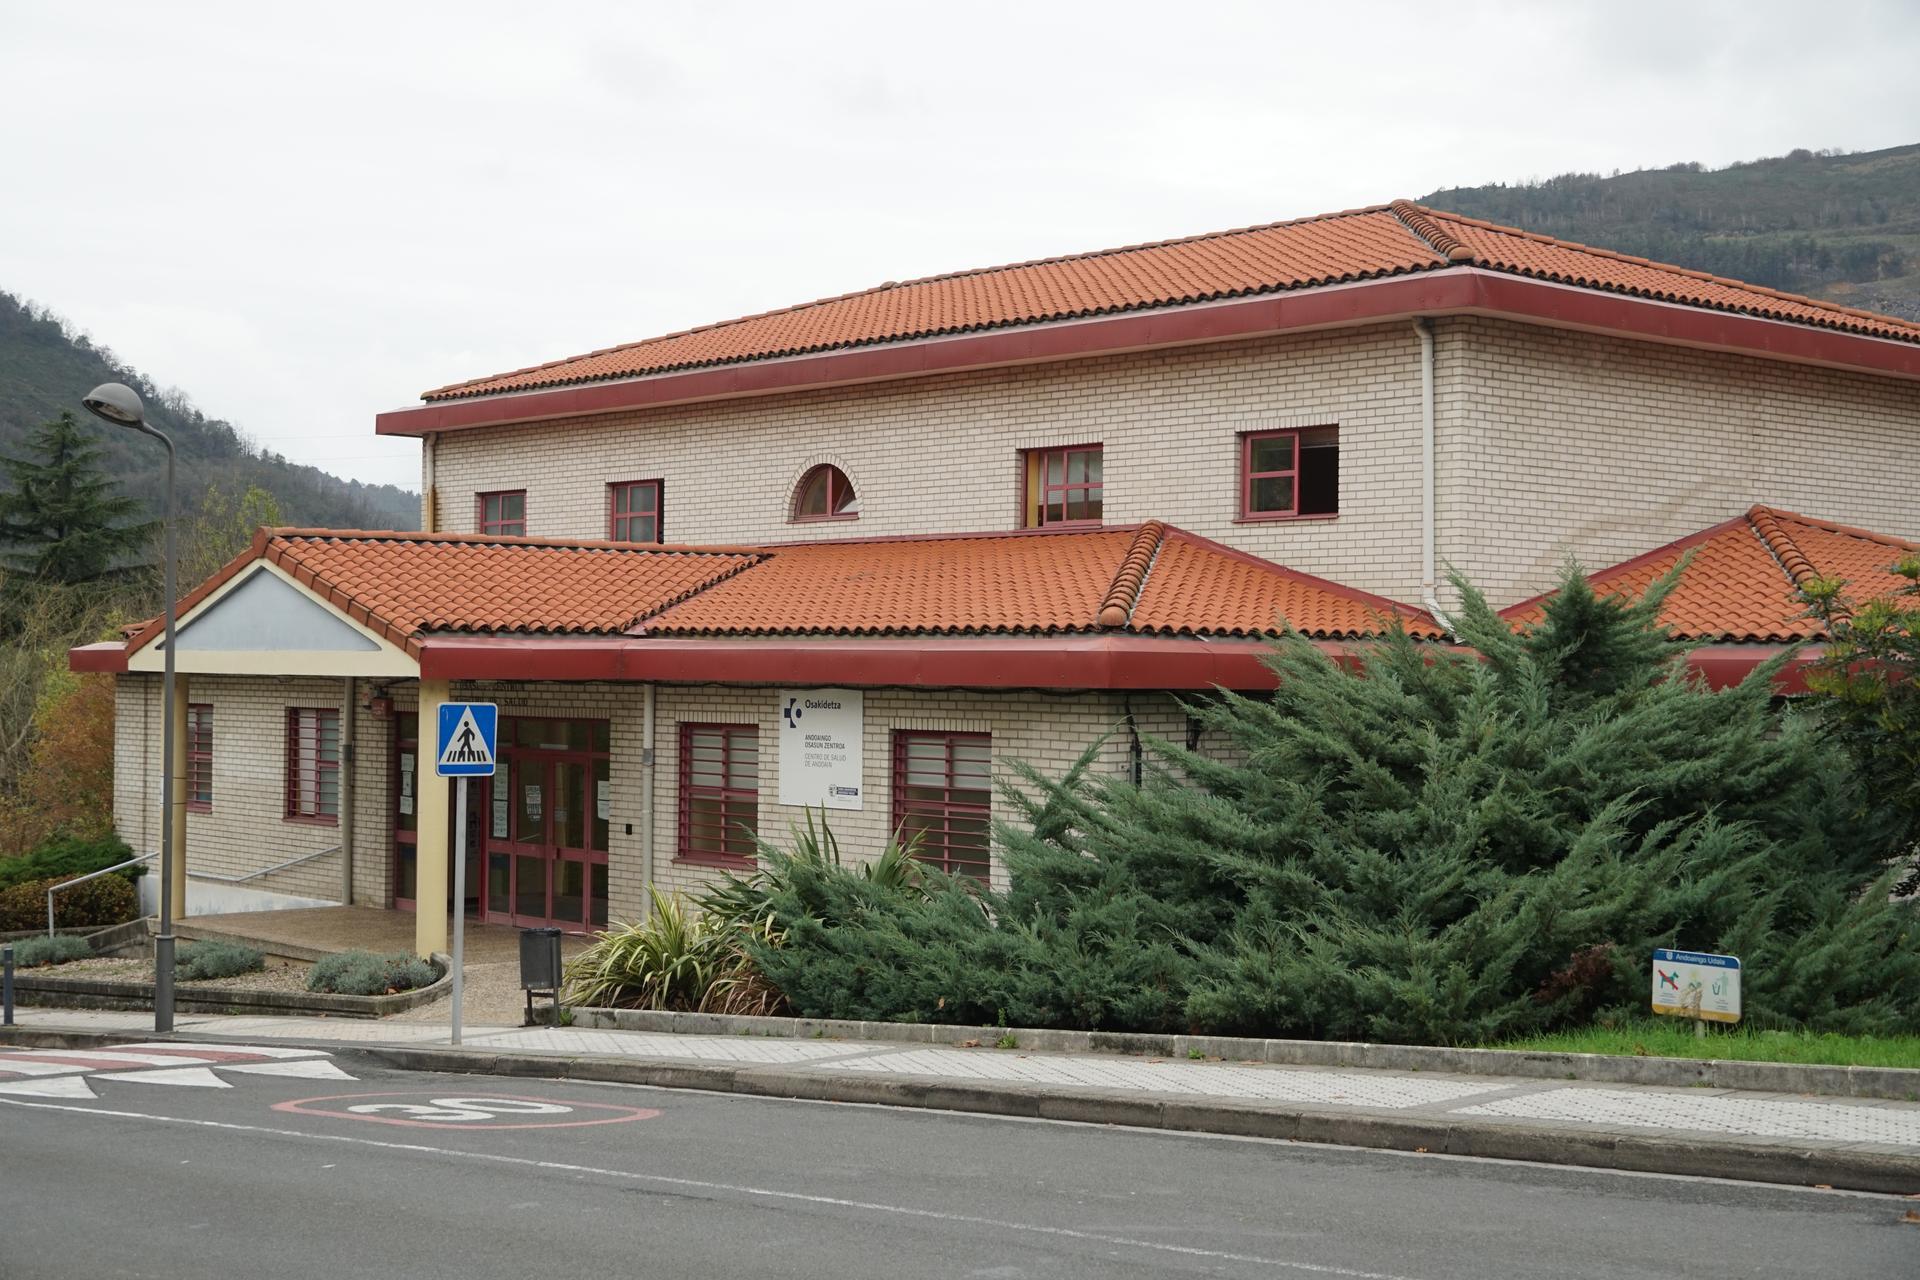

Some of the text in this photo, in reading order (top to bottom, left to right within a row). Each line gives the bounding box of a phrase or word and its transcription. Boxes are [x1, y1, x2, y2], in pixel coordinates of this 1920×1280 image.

[805, 699, 842, 709] Osakidetza
[1676, 953, 1726, 966] Andoaingo Udala
[347, 1098, 573, 1121] 30
